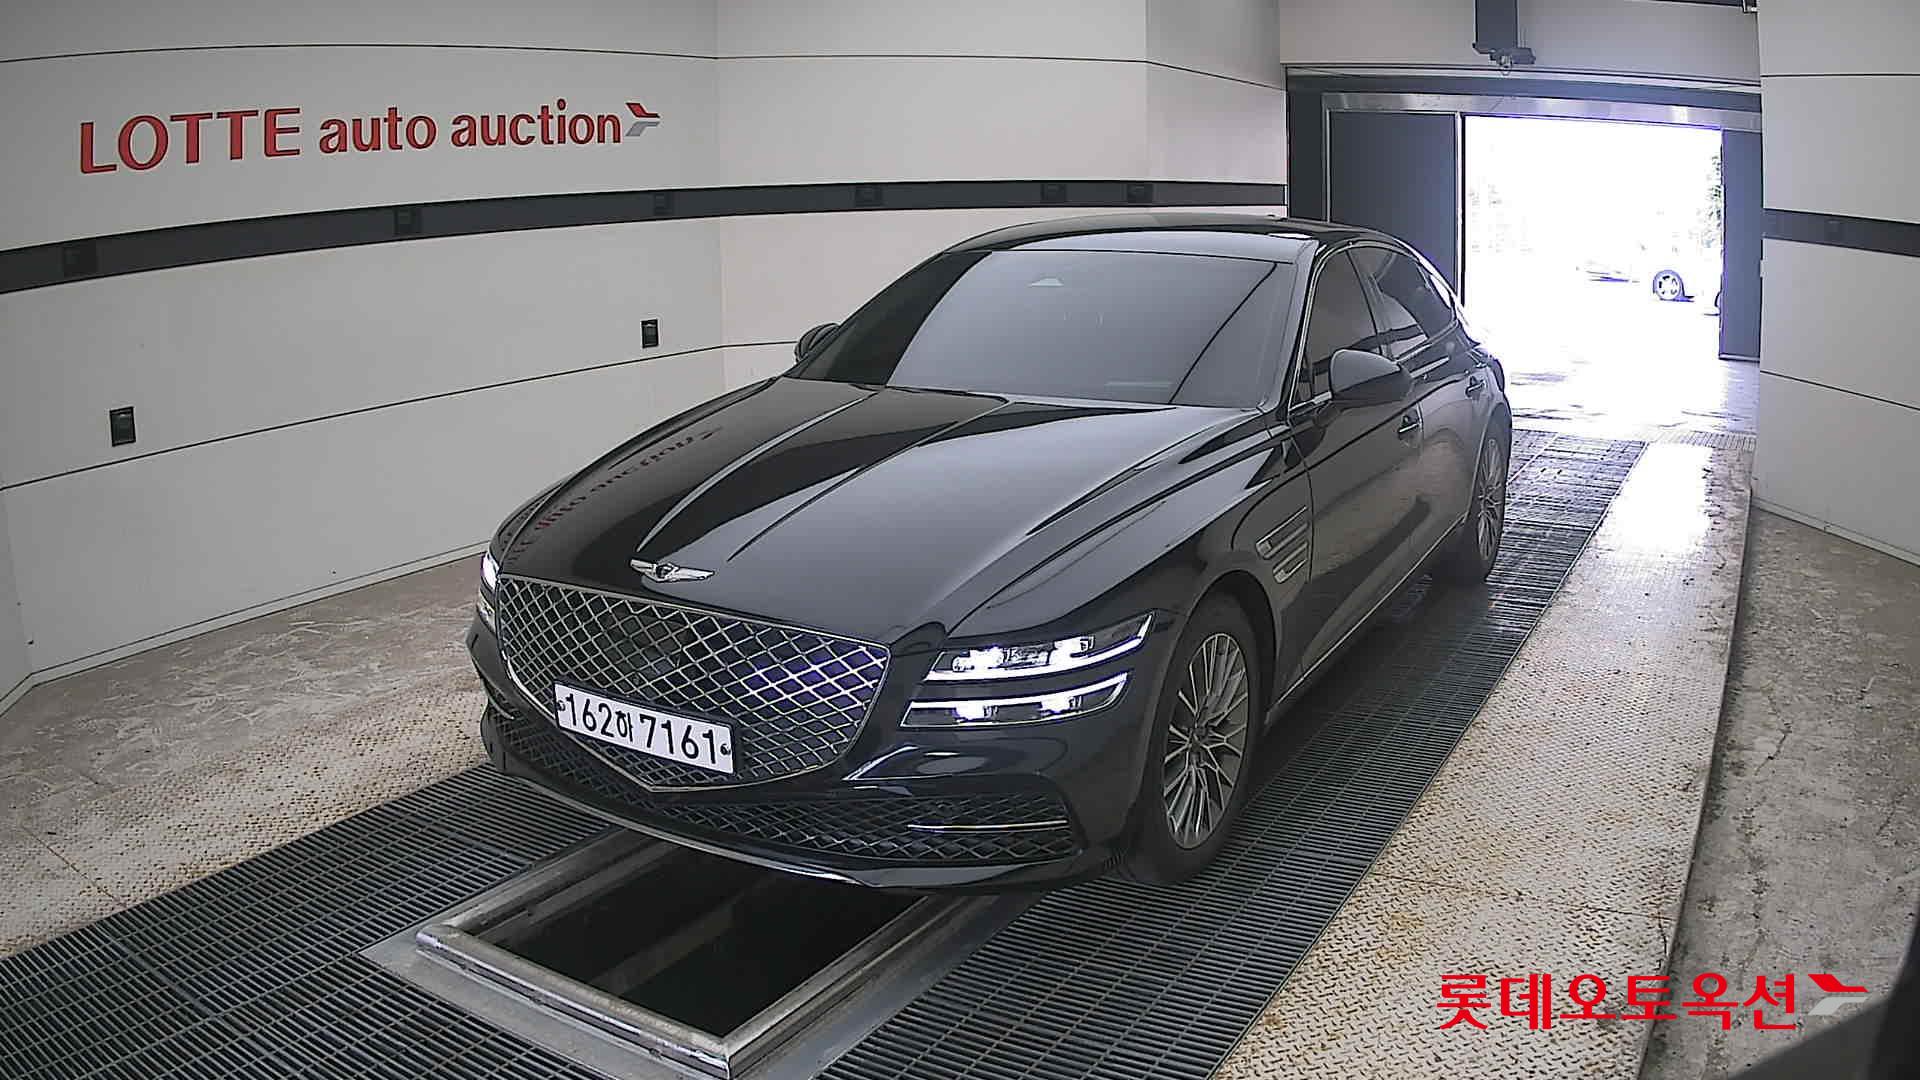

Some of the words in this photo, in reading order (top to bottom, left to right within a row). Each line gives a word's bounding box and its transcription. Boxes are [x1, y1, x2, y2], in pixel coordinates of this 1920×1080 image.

[79, 107, 301, 174] LOTTE
[318, 106, 438, 154] auto
[450, 98, 623, 148] auction
